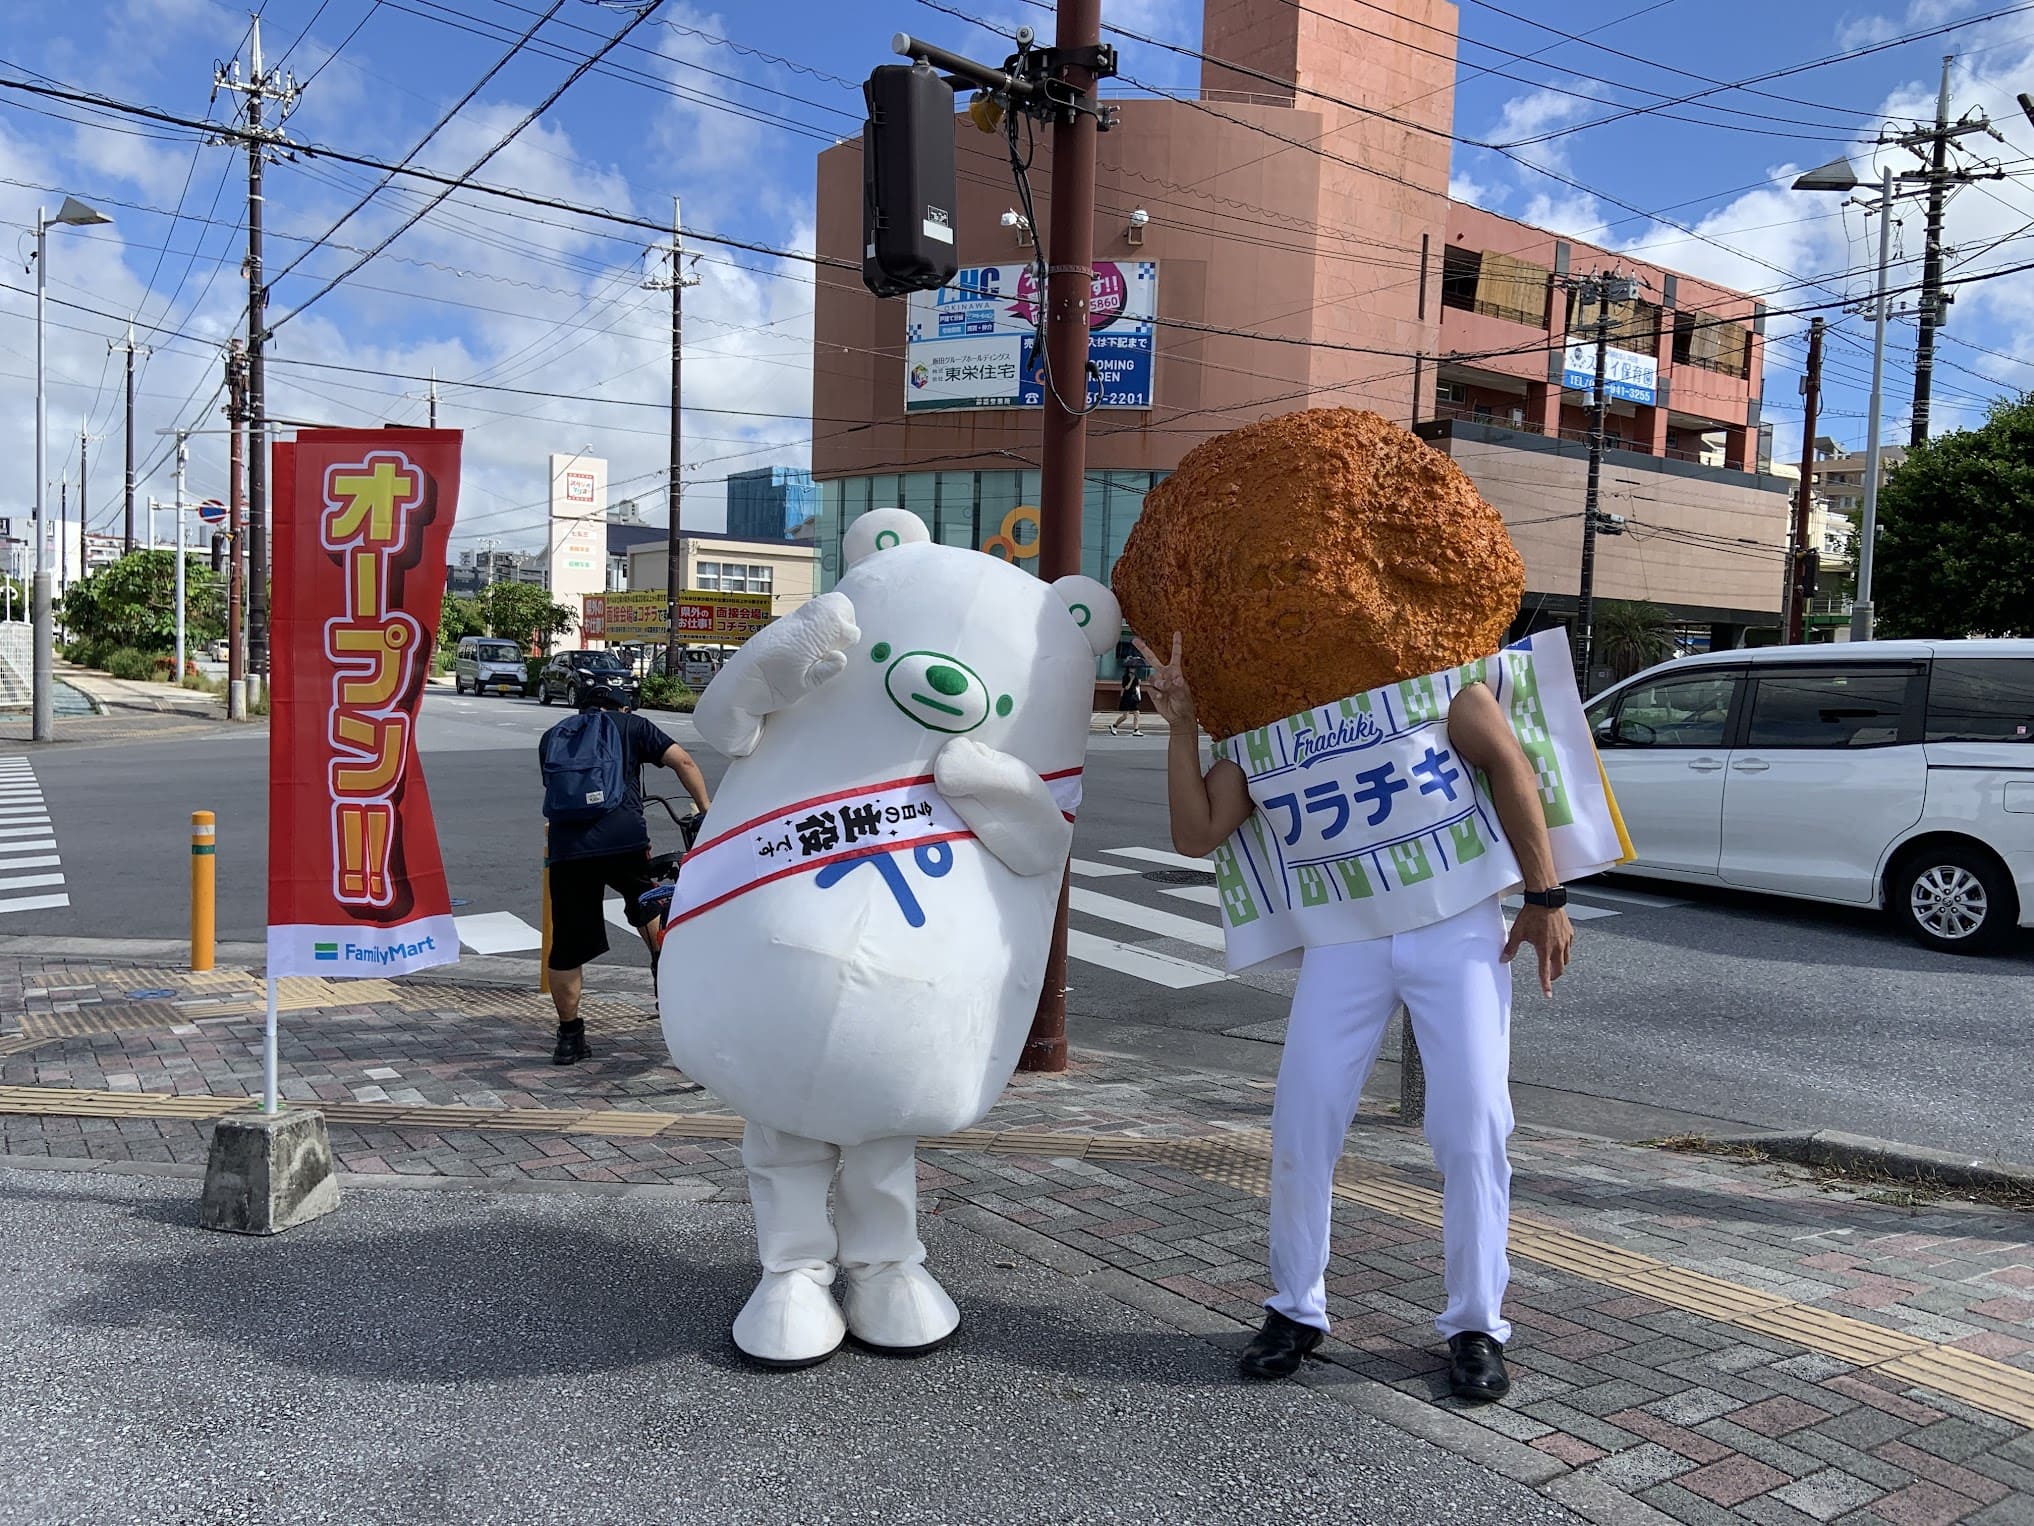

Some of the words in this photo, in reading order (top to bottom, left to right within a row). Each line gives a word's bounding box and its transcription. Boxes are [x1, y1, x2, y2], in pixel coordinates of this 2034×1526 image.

[937, 268, 1000, 306] HC
[944, 302, 990, 312] OKINAWA
[945, 364, 1015, 382] 東栄住宅
[1089, 359, 1135, 371] OMING
[1587, 355, 1653, 386] スイ保育園
[1570, 375, 1652, 402] TEL/0-941-3255
[680, 605, 709, 617] 県外の
[716, 606, 769, 620] 面接会場は
[678, 618, 712, 630] お仕事!
[1293, 713, 1383, 766] Frachiki
[1263, 747, 1459, 846] フラチキ
[345, 936, 436, 965] FamilyMart
